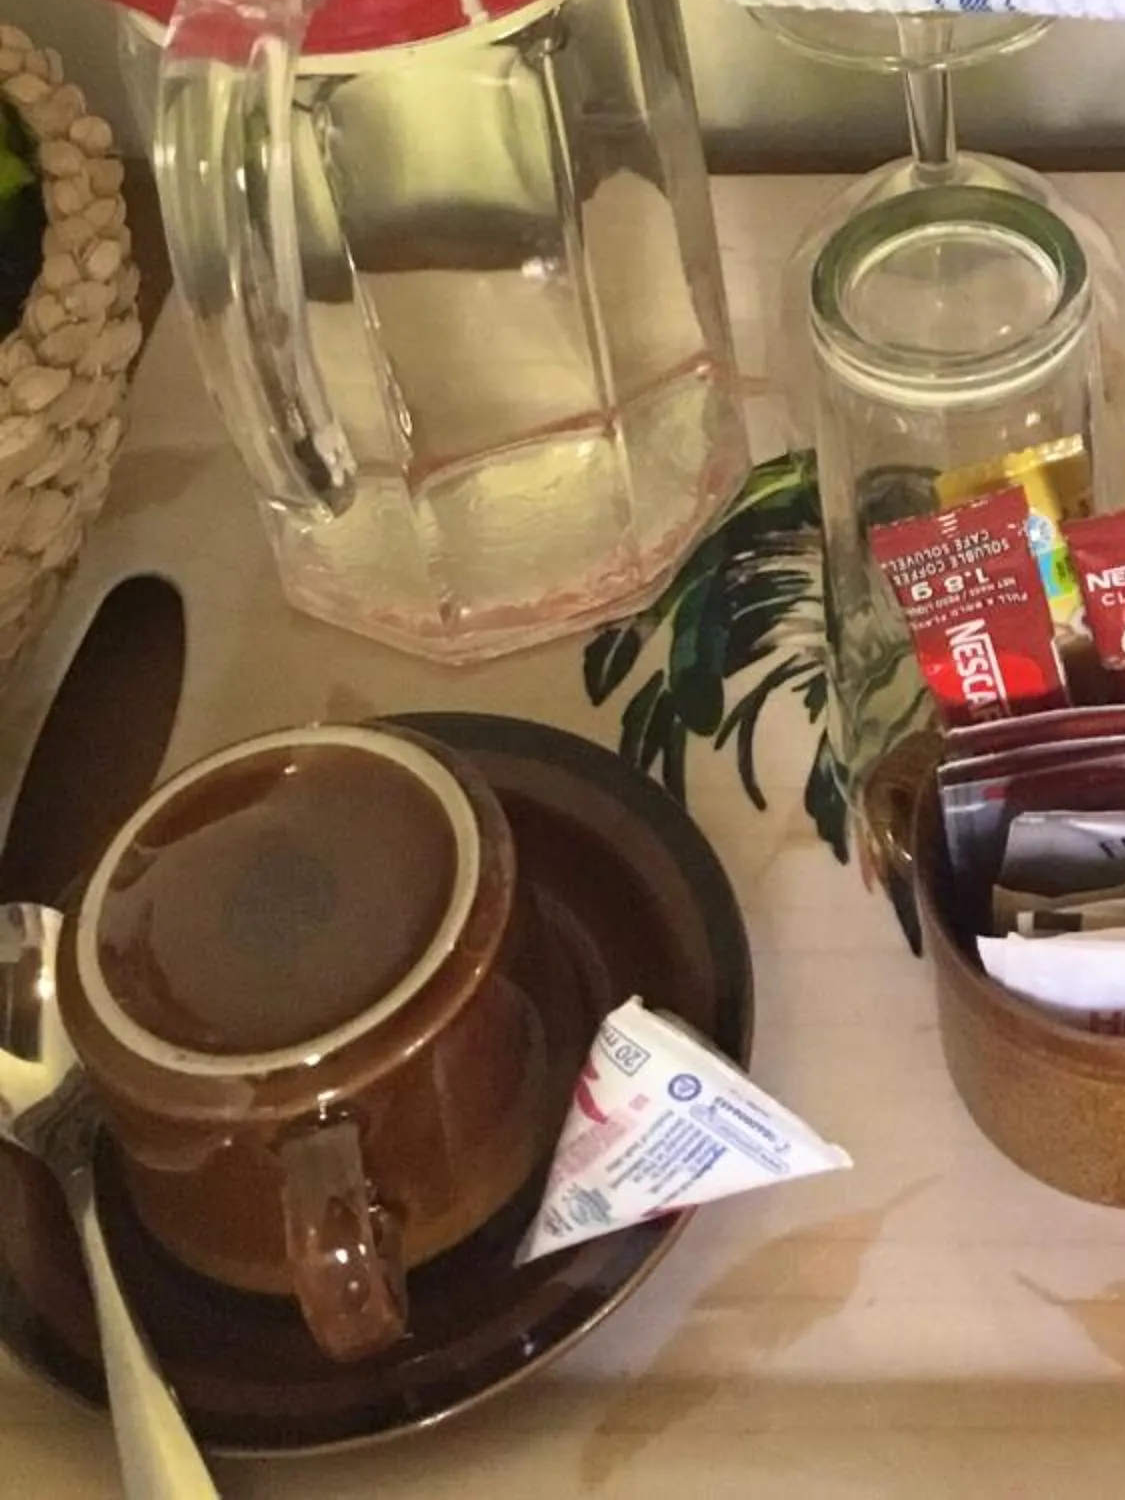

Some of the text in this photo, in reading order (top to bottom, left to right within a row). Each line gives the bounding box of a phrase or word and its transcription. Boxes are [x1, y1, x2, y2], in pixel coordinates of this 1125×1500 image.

[893, 537, 1010, 587] SOLUBLE COFFEE
[944, 567, 990, 593] 1.8
[615, 1044, 642, 1068] 20
